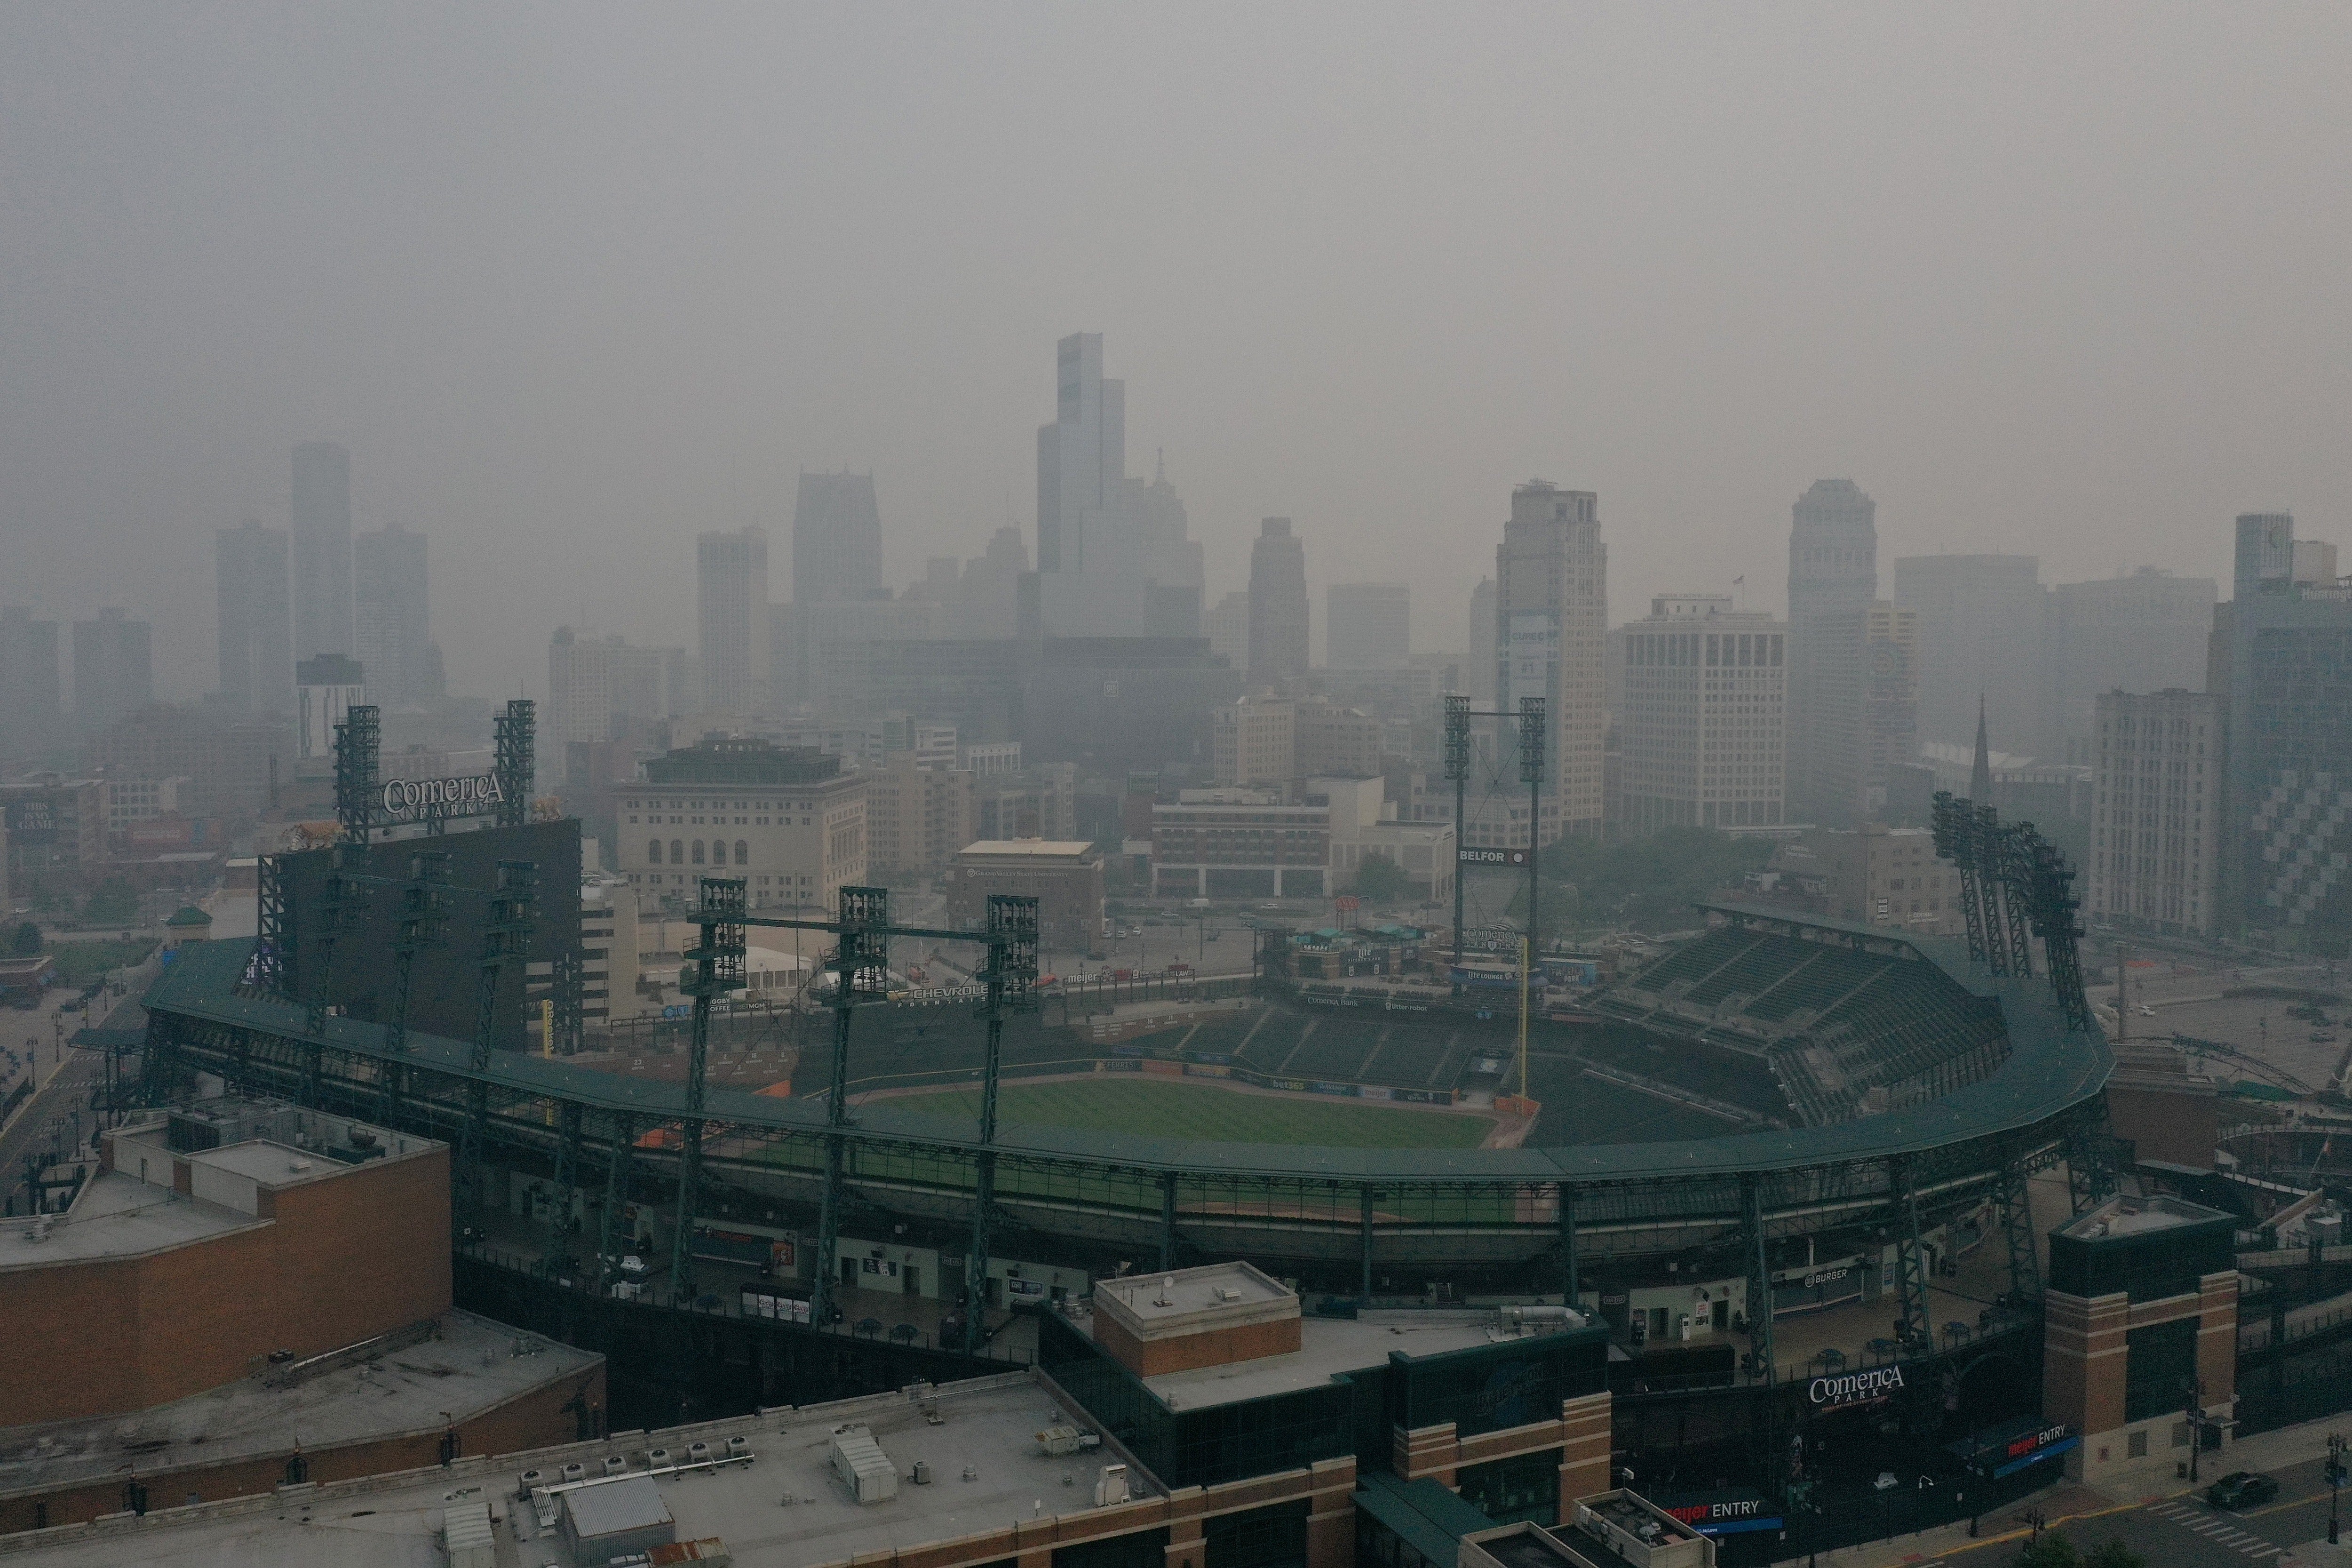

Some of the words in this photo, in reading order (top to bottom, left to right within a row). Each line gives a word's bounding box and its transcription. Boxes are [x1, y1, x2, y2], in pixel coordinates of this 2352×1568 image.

[420, 802, 473, 819] PARK
[1460, 851, 1504, 861] BELFOR
[1068, 971, 1097, 983] meijer
[1468, 971, 1480, 979] Lite
[914, 985, 988, 999] CHEVROLE
[1341, 997, 1358, 1006] Bank
[1273, 1080, 1304, 1090] bet365
[1816, 1269, 1847, 1284] BURGER
[1835, 1388, 1878, 1403] PARK
[2009, 1436, 2037, 1456] meijer
[2039, 1425, 2065, 1444] ENTRY
[1713, 1500, 1759, 1517] ENTRY
